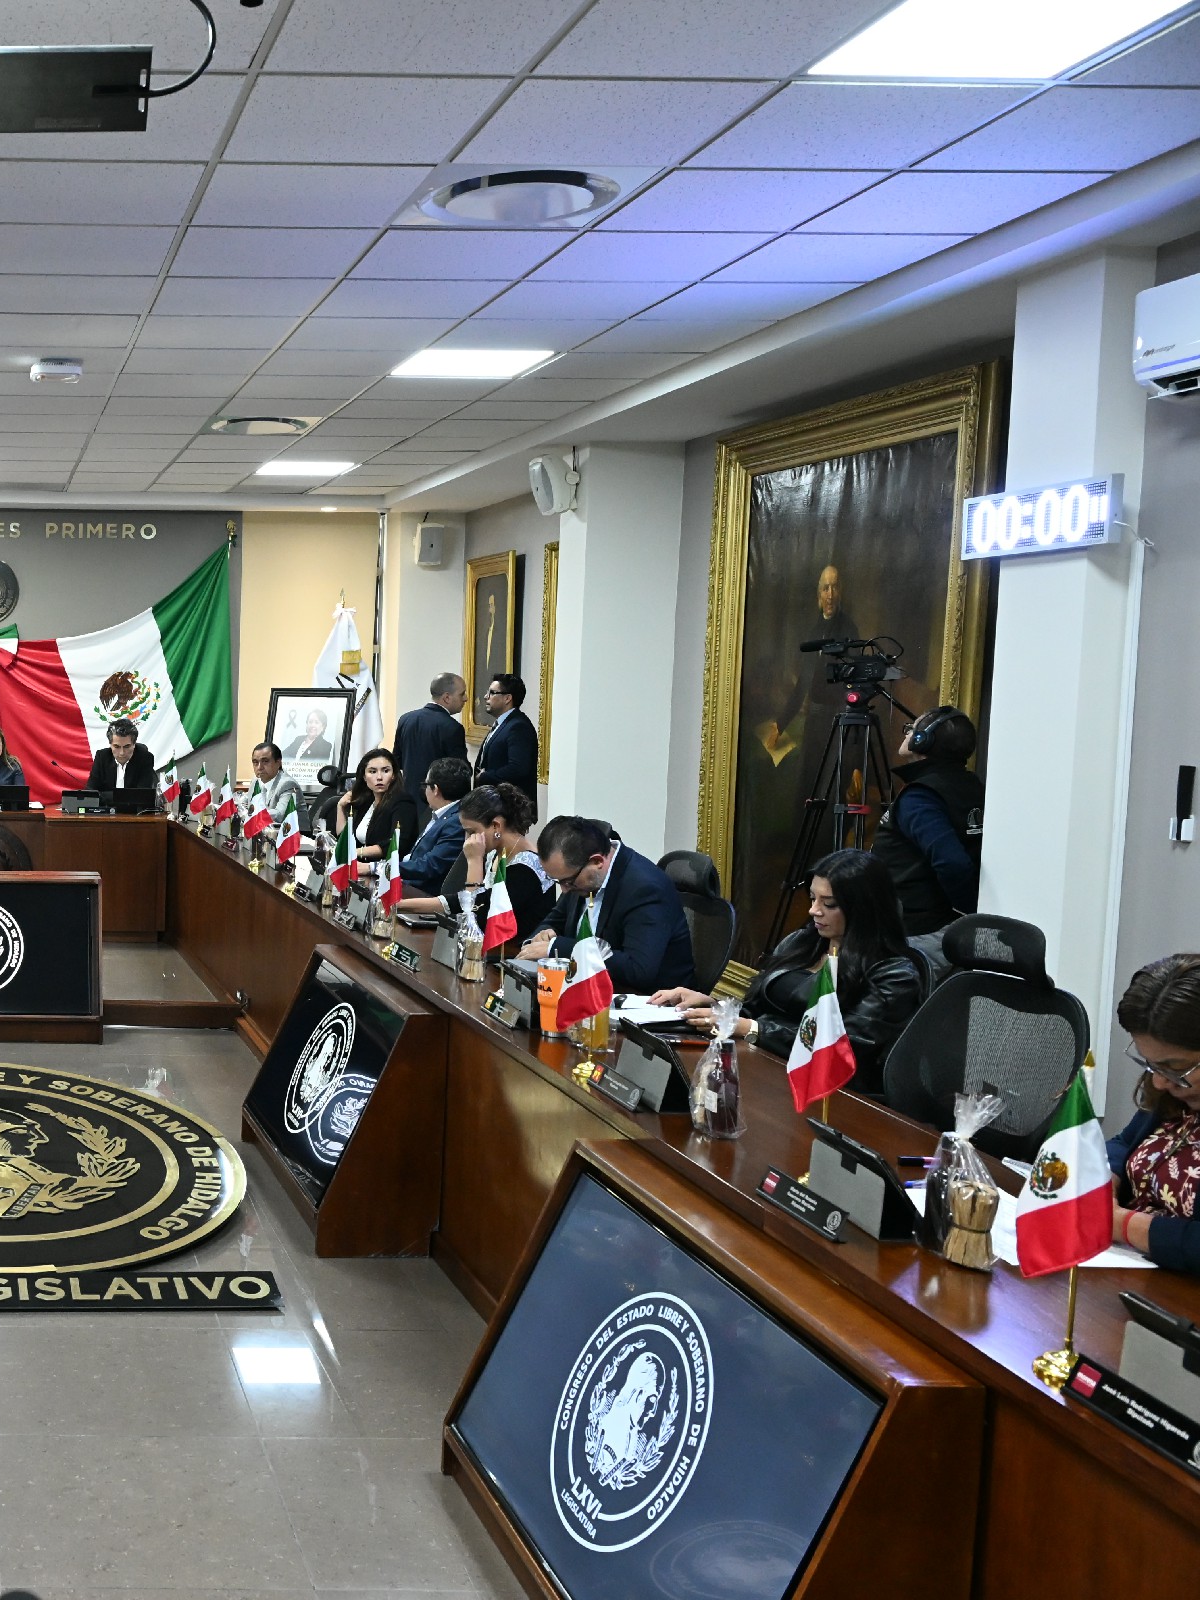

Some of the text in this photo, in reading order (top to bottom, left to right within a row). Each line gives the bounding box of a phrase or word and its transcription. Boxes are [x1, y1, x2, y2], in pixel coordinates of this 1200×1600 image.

[45, 523, 157, 539] PRIMERO
[18, 1073, 43, 1085] Y
[49, 1080, 198, 1146] SOBERANO
[188, 1146, 213, 1166] DE
[140, 1165, 223, 1240] HIDALGO
[560, 1304, 706, 1520] CONGRESO DEL ESTADO LIBRE Y SOBERANO DE HIDALGO
[560, 1488, 597, 1539] LEGISLATURA
[570, 1476, 602, 1520] LXVI
